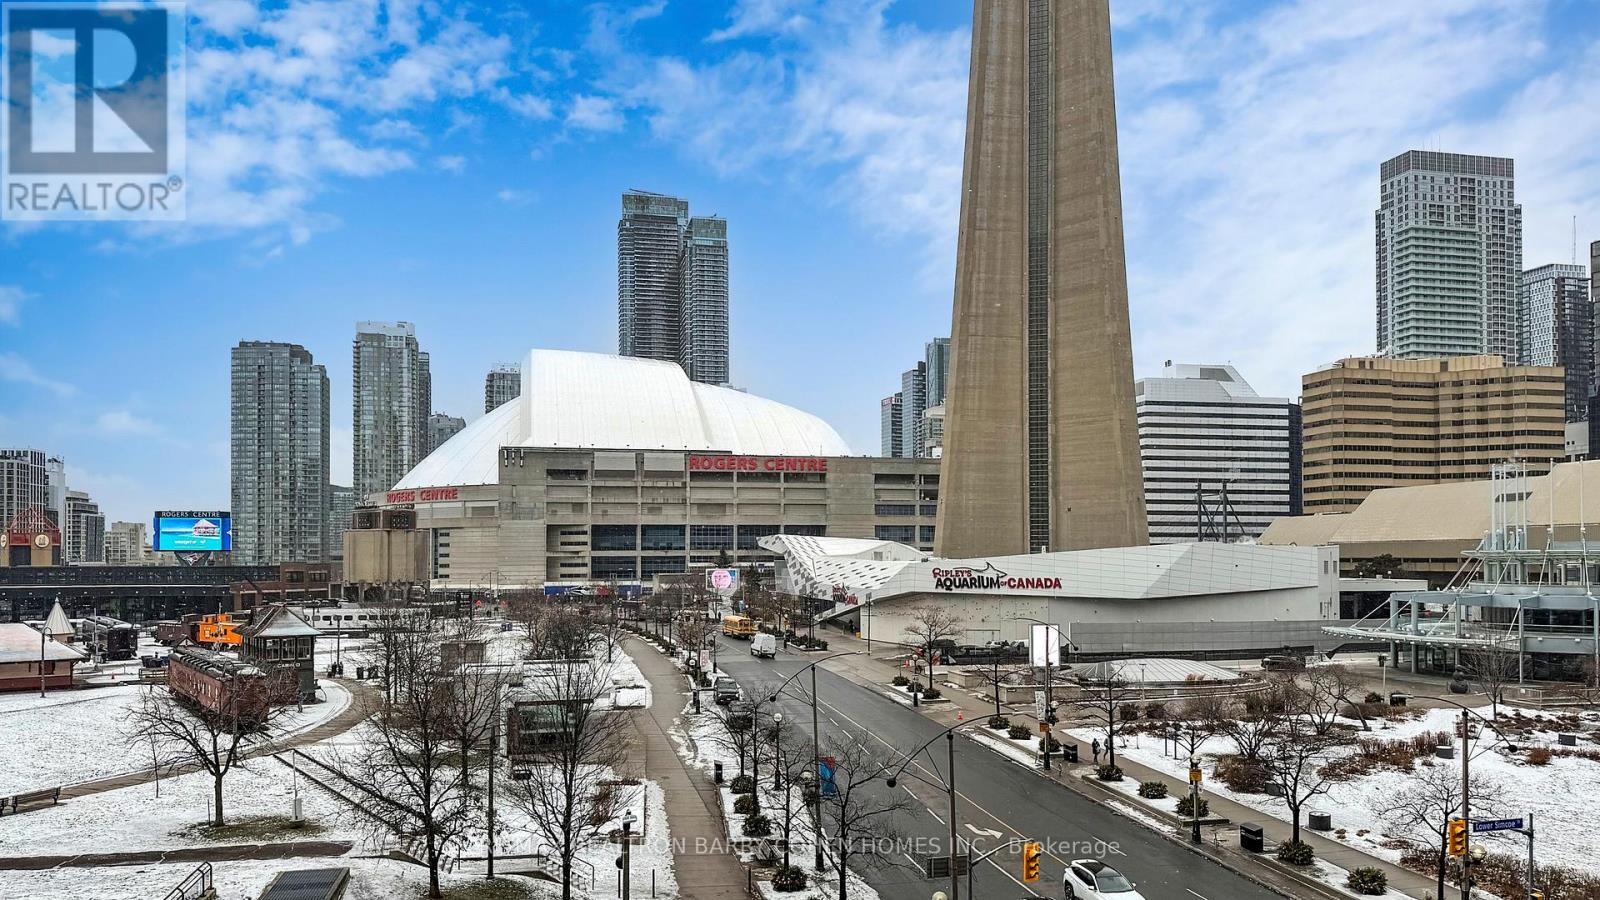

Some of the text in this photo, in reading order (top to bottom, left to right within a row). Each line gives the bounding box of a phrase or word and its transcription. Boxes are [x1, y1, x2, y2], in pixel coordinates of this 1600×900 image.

[688, 455, 827, 472] ROGERS CENTRE
[386, 490, 415, 503] ROGERS
[420, 488, 458, 501] CENTRE
[935, 575, 1000, 591] AQUARIUM
[1008, 577, 1062, 589] CANADA
